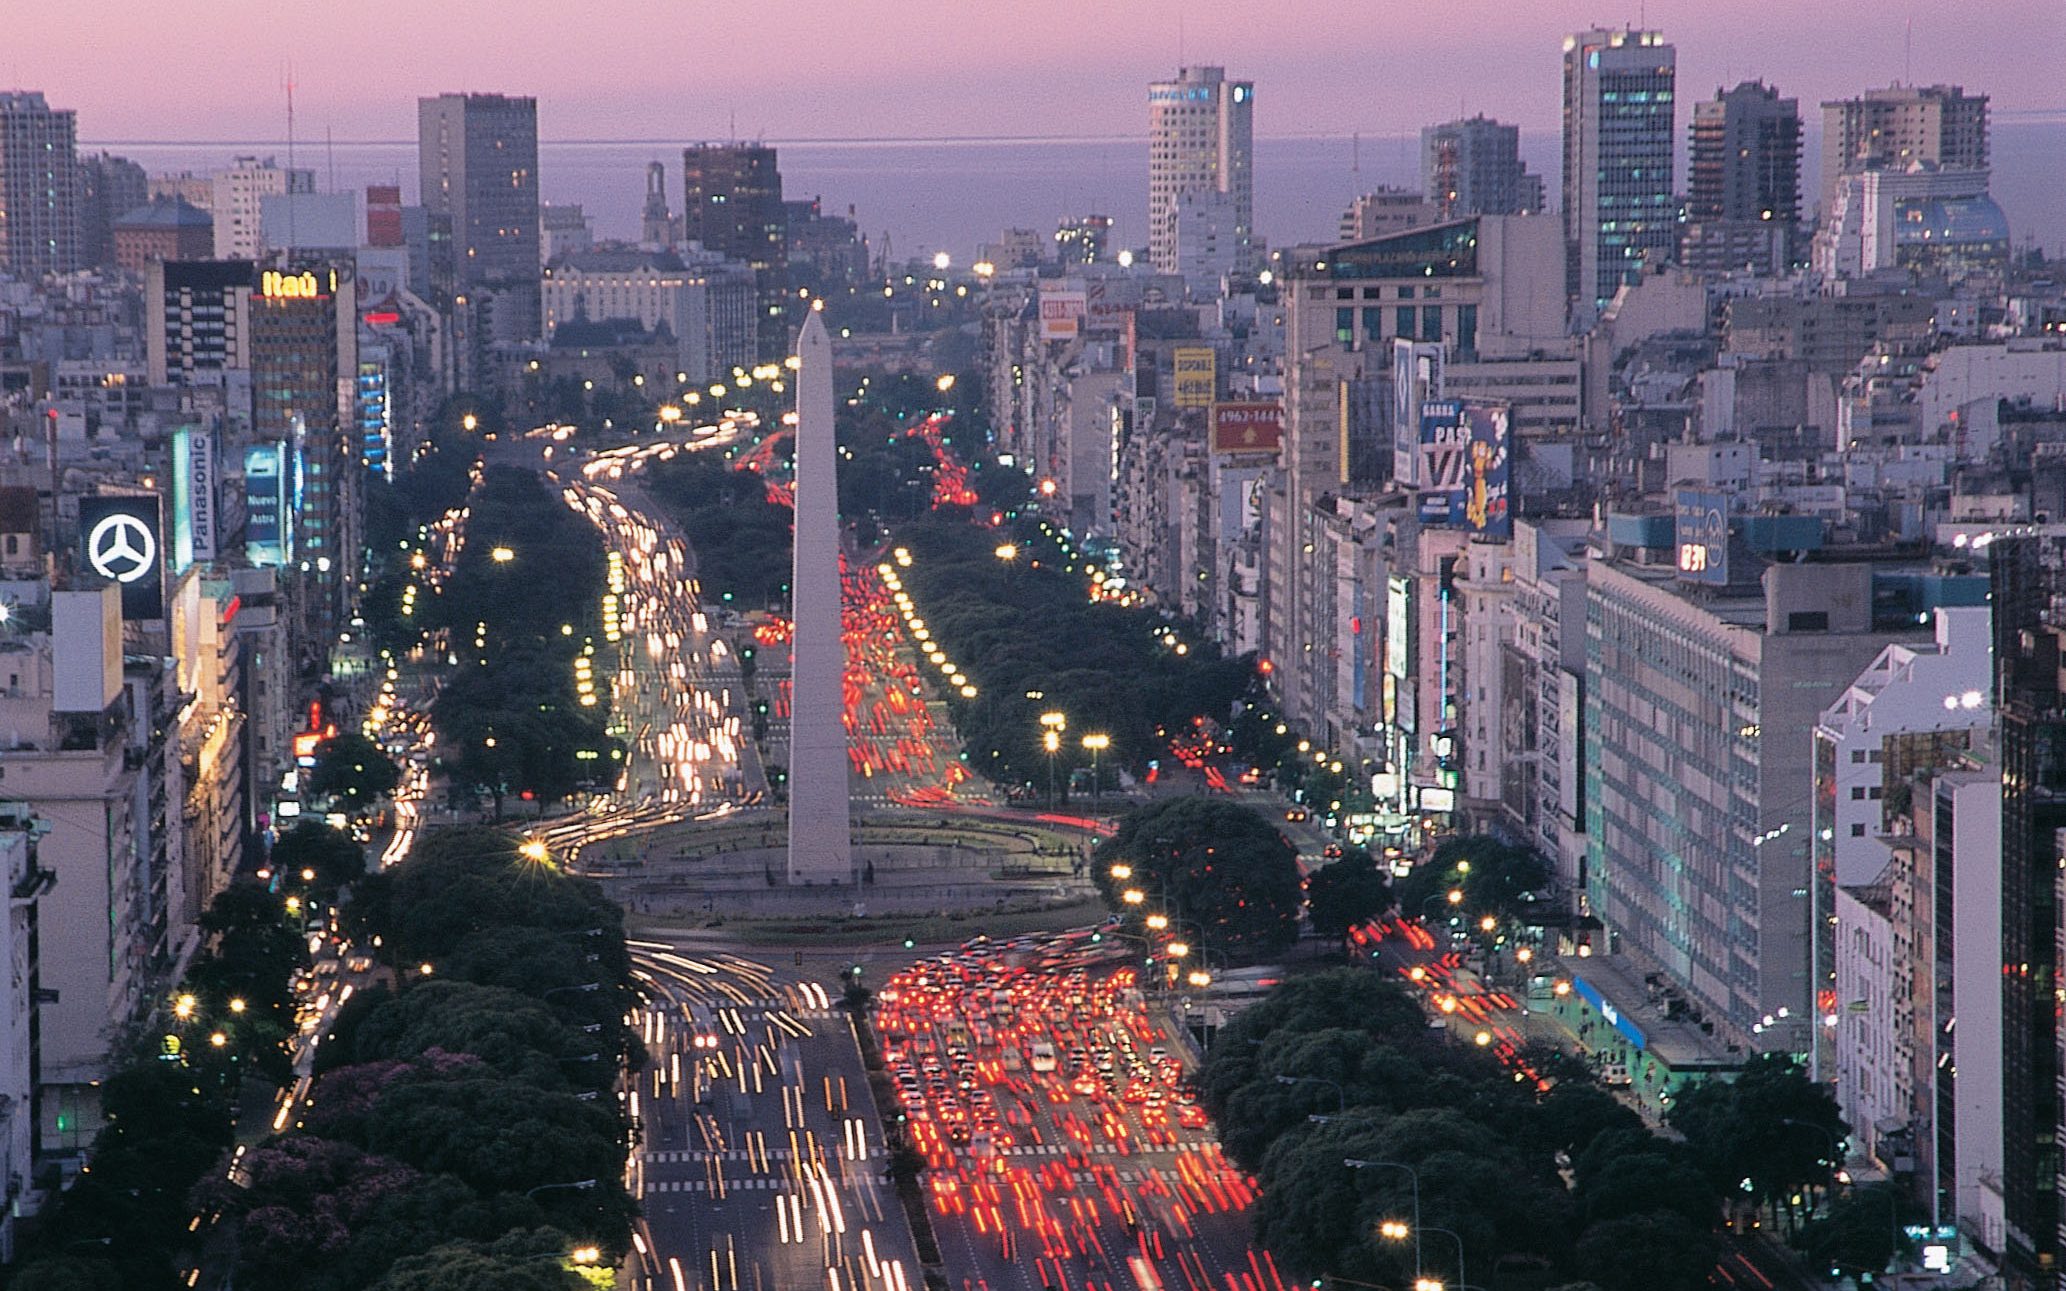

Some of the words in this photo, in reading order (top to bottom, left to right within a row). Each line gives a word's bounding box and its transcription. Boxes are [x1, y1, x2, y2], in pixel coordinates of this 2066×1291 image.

[263, 271, 318, 298] Itaú
[193, 437, 208, 550] Panasonic
[247, 495, 277, 506] Nuevo
[250, 514, 275, 524] Astra
